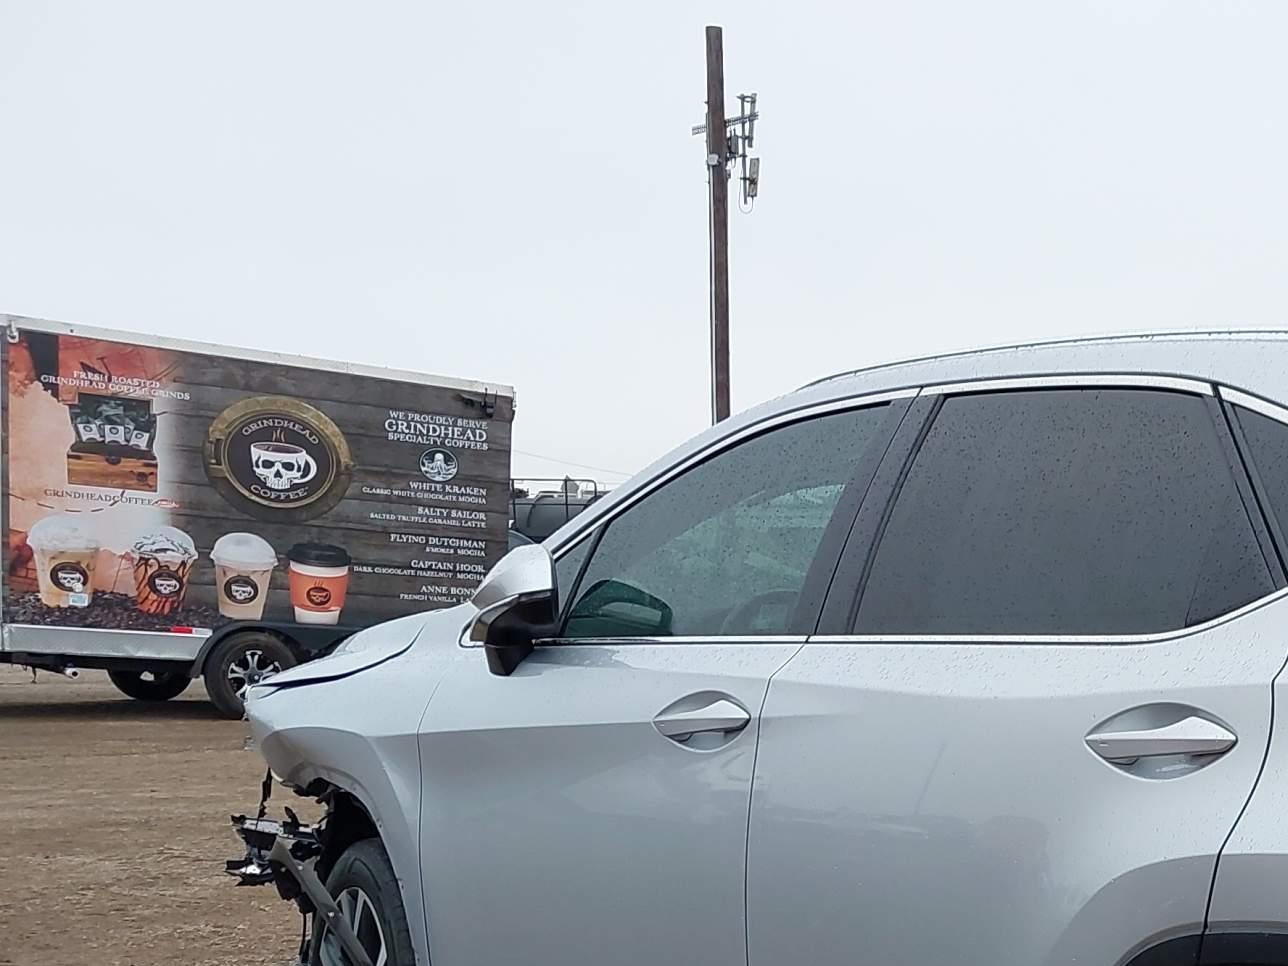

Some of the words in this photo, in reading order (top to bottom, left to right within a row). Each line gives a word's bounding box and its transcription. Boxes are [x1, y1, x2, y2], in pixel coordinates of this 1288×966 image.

[40, 374, 106, 390] GRINDHEAD
[108, 383, 150, 396] COFFEE
[151, 388, 190, 400] GRINDS
[73, 370, 108, 383] FRESH
[111, 374, 160, 389] ROASTED
[389, 410, 406, 420] WE
[407, 413, 456, 426] PROUDLY
[457, 418, 488, 430] SERVE
[241, 418, 319, 444] GRINDHEAD
[384, 419, 487, 441] GRINDHEAD
[388, 432, 443, 446] SPECIALTY
[444, 438, 489, 451] COFFEES
[250, 484, 308, 500] COFFEE
[362, 486, 391, 495] CLASSIC
[392, 490, 415, 498] WHITE
[416, 492, 456, 502] CHOCOLATE
[457, 495, 487, 505] MOCHA
[409, 481, 443, 492] WHITE
[445, 484, 487, 496] KRAKEN
[369, 512, 396, 520] SALTED
[397, 515, 427, 524] TRUFFLE
[428, 518, 461, 526] CARAMEL
[461, 520, 487, 529] LATTE
[417, 506, 449, 516] SALTY
[450, 510, 486, 521] SAILOR
[390, 533, 427, 544] FLYING
[428, 536, 486, 549] DUTCHMAN
[457, 549, 486, 557] MOCHA
[353, 565, 373, 573] DARK
[374, 567, 416, 576] CHOCOLATE
[416, 570, 453, 579] HAZELNUT
[456, 572, 486, 581] MOCHA
[411, 559, 454, 571] CAPTAIN
[456, 563, 486, 573] HOOK
[420, 585, 448, 594] ANNE
[399, 593, 427, 601] FRENCH
[429, 595, 457, 603] VANILLA
